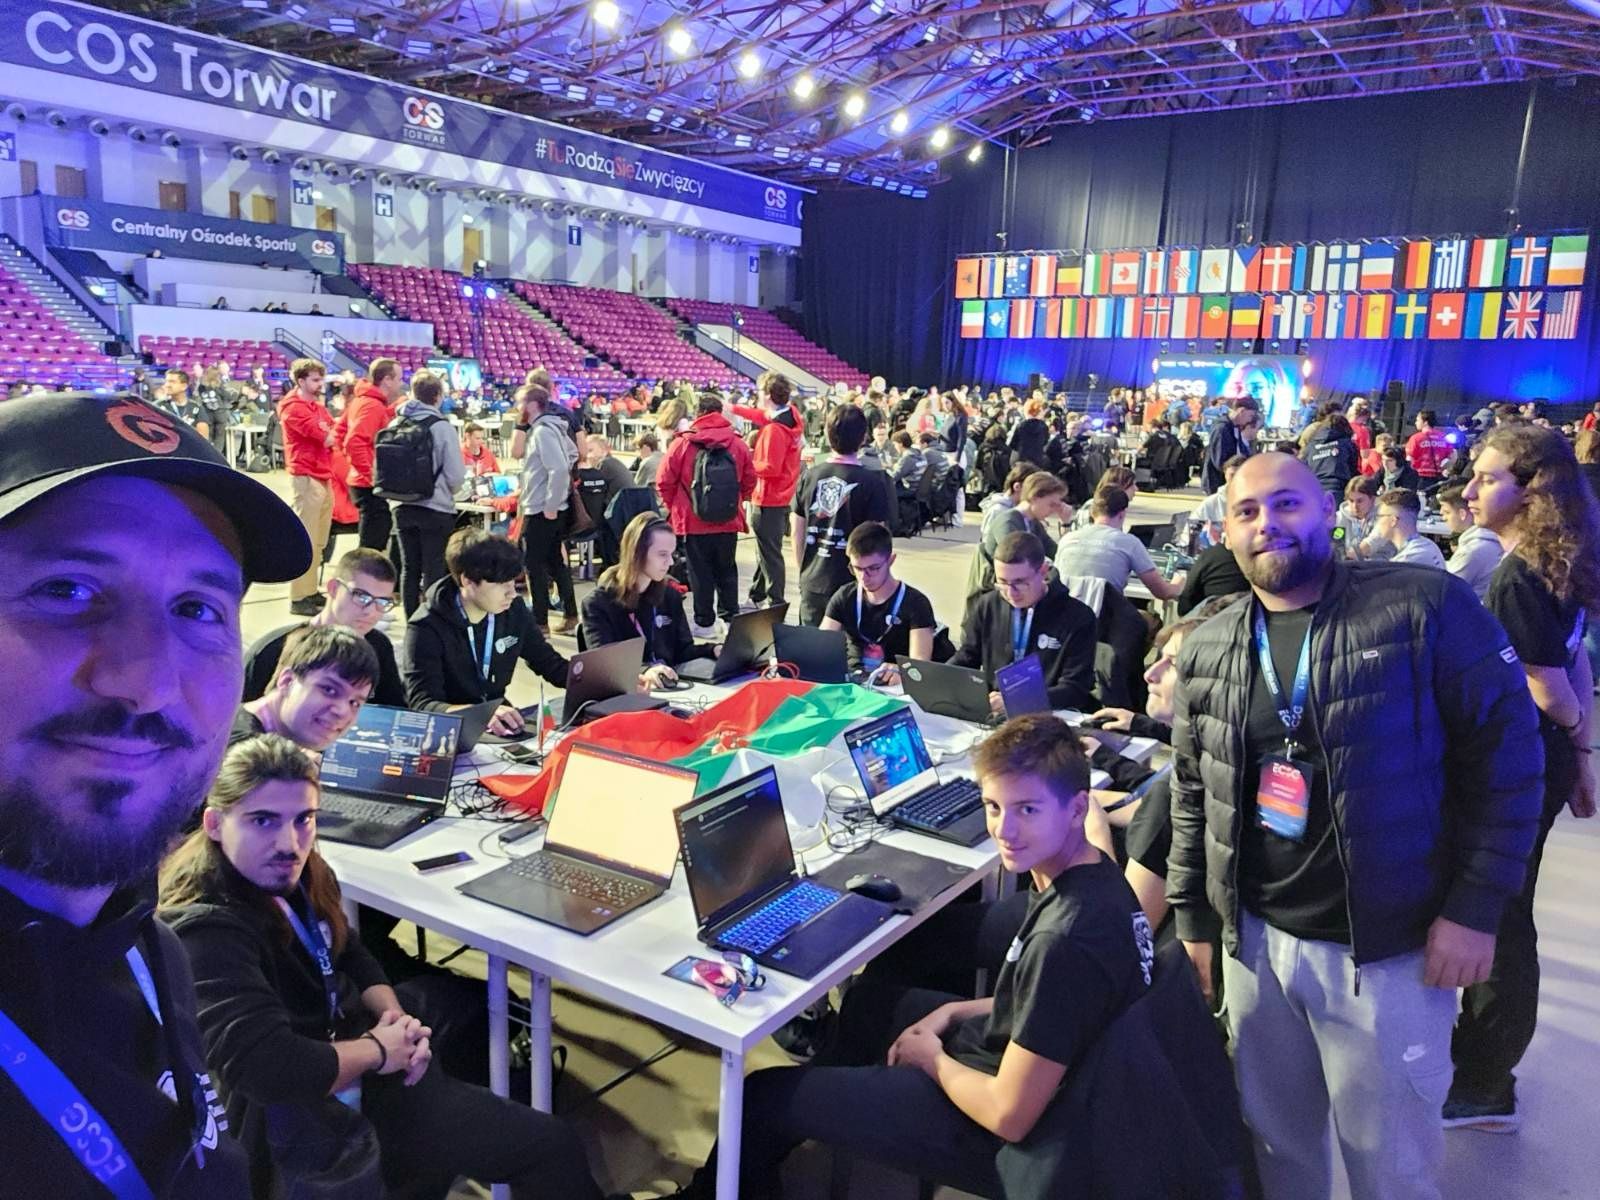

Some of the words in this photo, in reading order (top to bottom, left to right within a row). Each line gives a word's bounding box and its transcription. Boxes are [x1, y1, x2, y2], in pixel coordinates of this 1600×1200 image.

[25, 10, 158, 84] COS
[173, 42, 337, 121] Torwar
[403, 128, 446, 145] TORWAR
[377, 197, 391, 215] H
[111, 218, 187, 243] Centralny
[191, 227, 252, 247] Ośrodek
[255, 235, 296, 253] Sportu
[60, 1102, 127, 1178] ECSC
